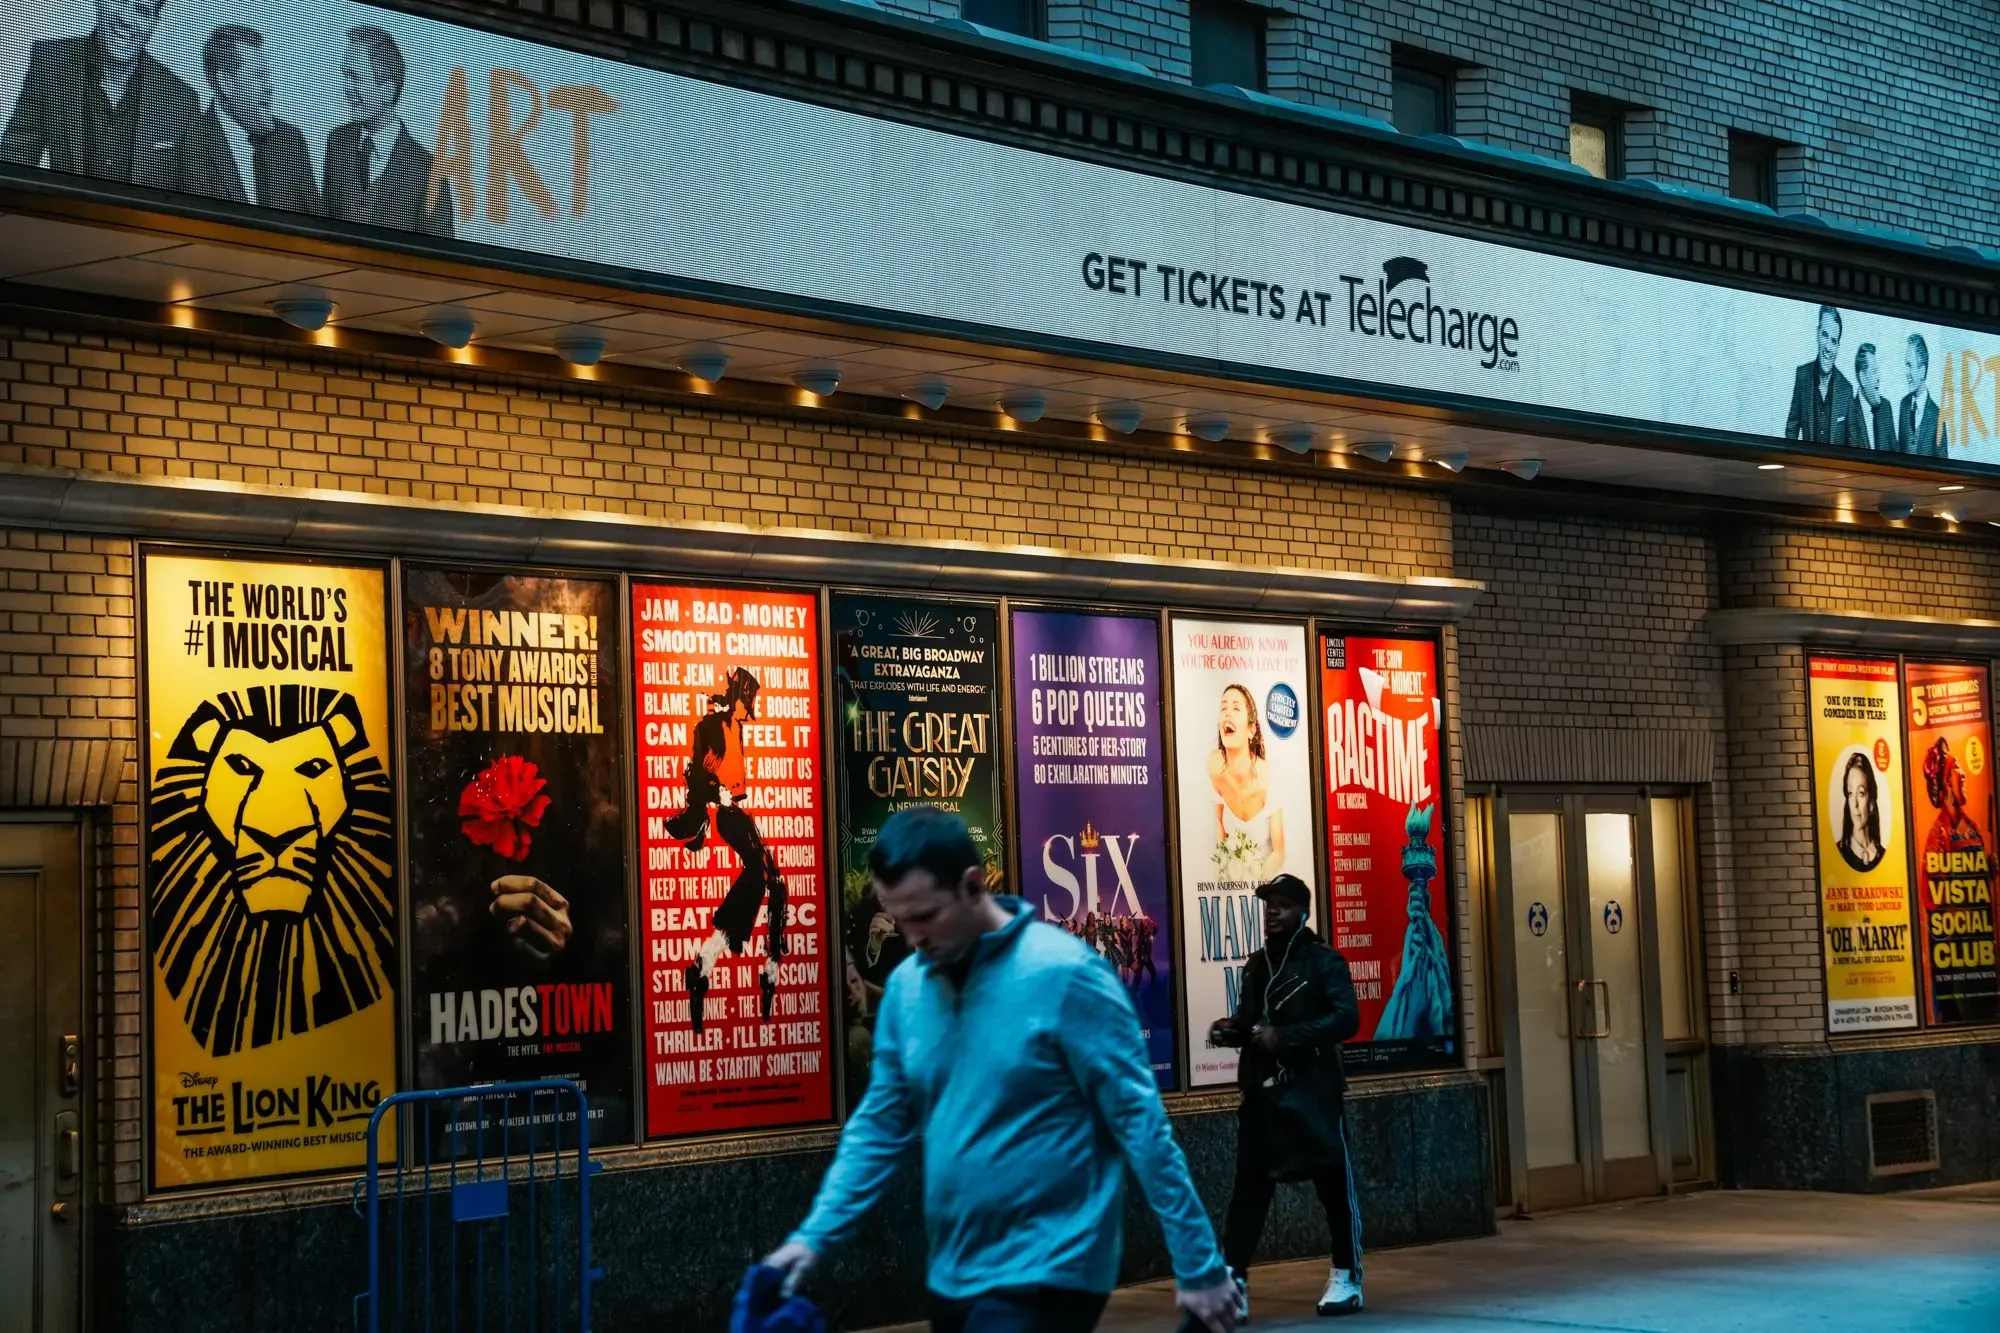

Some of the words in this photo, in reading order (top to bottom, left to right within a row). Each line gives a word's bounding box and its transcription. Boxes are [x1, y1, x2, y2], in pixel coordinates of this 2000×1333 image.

[426, 65, 622, 224] ART
[1083, 252, 1146, 296] GET
[1157, 264, 1286, 320] TICKETS
[1296, 289, 1331, 326] AT
[1340, 274, 1519, 368] Telecharge
[189, 580, 234, 617] THE
[242, 583, 348, 623] WORLD'S
[641, 598, 680, 622] JAM
[692, 601, 733, 625] BAD
[743, 604, 807, 629] MONEY
[424, 607, 598, 650] WINNER!
[184, 620, 215, 667] #1
[223, 622, 353, 672] MUSICAL
[642, 629, 721, 655] SMOOTH
[725, 633, 808, 659] CRIMINAL
[902, 648, 921, 661] BIG
[924, 649, 984, 663] BROADWAY
[1188, 633, 1208, 649] YOU
[1210, 634, 1255, 651] ALREADY
[1259, 638, 1289, 652] KNOW
[1327, 638, 1344, 648] LINCOLN
[1327, 648, 1344, 658] CENTER
[429, 647, 444, 680] 8
[448, 648, 504, 682] TONY
[508, 650, 588, 685] AWARDS
[874, 663, 960, 679] EXTRAVAGANZA
[1030, 654, 1036, 681] 1
[1039, 654, 1086, 683] BILLION
[1089, 656, 1145, 685] STREAMS
[1180, 653, 1216, 670] YOU'RE
[1218, 655, 1254, 671] GONNA
[1328, 658, 1345, 667] THEATER
[1387, 649, 1402, 669] SHOW
[643, 661, 680, 686] BILLIE
[683, 663, 714, 687] JEAN
[764, 667, 783, 689] YOU
[785, 667, 810, 690] BACK
[850, 680, 867, 690] THAT
[869, 681, 905, 692] EXPLODES
[907, 683, 925, 692] WITH
[926, 684, 940, 693] LIFE
[941, 684, 956, 693] AND
[1842, 696, 1851, 706] OF
[1853, 697, 1866, 707] THE
[1868, 698, 1883, 708] BEST
[1926, 684, 1947, 699] TONY
[1948, 680, 1979, 697] AWARDS
[430, 683, 493, 731] BEST
[498, 685, 604, 734] MUSICAL
[644, 692, 690, 716] BLAME
[695, 693, 708, 716] IT
[766, 696, 810, 719] BOOGIE
[1031, 689, 1042, 725] 6
[1047, 689, 1079, 726] POP
[1084, 690, 1146, 733] QUEENS
[1824, 708, 1857, 719] COMEDIES
[1858, 709, 1865, 719] IN
[1911, 686, 1928, 726] 5
[645, 722, 687, 746] CAN
[742, 725, 786, 747] FEEL
[793, 726, 811, 748] IT
[852, 711, 896, 752] THE
[902, 712, 991, 754] GREAT
[1033, 736, 1039, 756] 5
[1041, 736, 1087, 757] CENTURIES
[1089, 737, 1099, 757] OF
[1101, 737, 1147, 757] HER-STORY
[1327, 699, 1431, 804] RAGTIME
[646, 756, 679, 778] THEY
[757, 757, 793, 779] ABOUT
[797, 757, 812, 780] US
[868, 755, 975, 798] GATSBY
[1034, 764, 1045, 784] 80
[1048, 764, 1109, 785] EXHILARATING
[1110, 765, 1148, 785] MINUTES
[738, 786, 813, 809] MACHINE
[888, 802, 895, 813] A
[1336, 793, 1346, 809] THE
[1347, 793, 1368, 809] MUSICAL
[754, 815, 814, 838] MIRROR
[649, 847, 680, 870] DON'T
[777, 845, 815, 867] ENOUGH
[1926, 851, 1988, 873] BUENA
[650, 877, 676, 901] KEEP
[678, 877, 699, 900] THE
[701, 876, 731, 899] FAITH
[787, 874, 816, 897] WHITE
[1042, 832, 1147, 923] SIX
[1197, 882, 1215, 892] BENNY
[1217, 880, 1249, 891] ANDERSSON
[1251, 881, 1256, 890] &
[1826, 887, 1849, 900] JANE
[1852, 886, 1904, 900] KRAKOWSKI
[1928, 879, 1991, 905] VISTA
[651, 907, 711, 931] BEAT
[1931, 910, 1993, 936] SOCIAL
[1934, 940, 1996, 969] CLUB
[737, 965, 752, 988] IN
[1368, 982, 1381, 999] ONLY
[430, 982, 613, 1044] HADESTOWN
[738, 995, 755, 1018] THE
[780, 992, 798, 1015] YOU
[799, 991, 820, 1014] SAVE
[507, 1045, 519, 1057] THE
[521, 1044, 540, 1056] MYTH.
[655, 1028, 723, 1054] THRILLER
[733, 1026, 757, 1049] I'LL
[760, 1023, 777, 1046] BE
[779, 1021, 821, 1044] THERE
[655, 1060, 696, 1086] WANNA
[699, 1059, 713, 1083] BE
[716, 1055, 763, 1081] STARTIN'
[766, 1051, 821, 1077] SOMETHIN'
[173, 1093, 225, 1126] THE
[232, 1081, 299, 1135] LION
[306, 1074, 381, 1128] KING
[184, 1147, 204, 1158] THE
[207, 1137, 301, 1156] AWARD-WINNING
[303, 1135, 328, 1146] BEST
[329, 1131, 368, 1143] MUSICA
